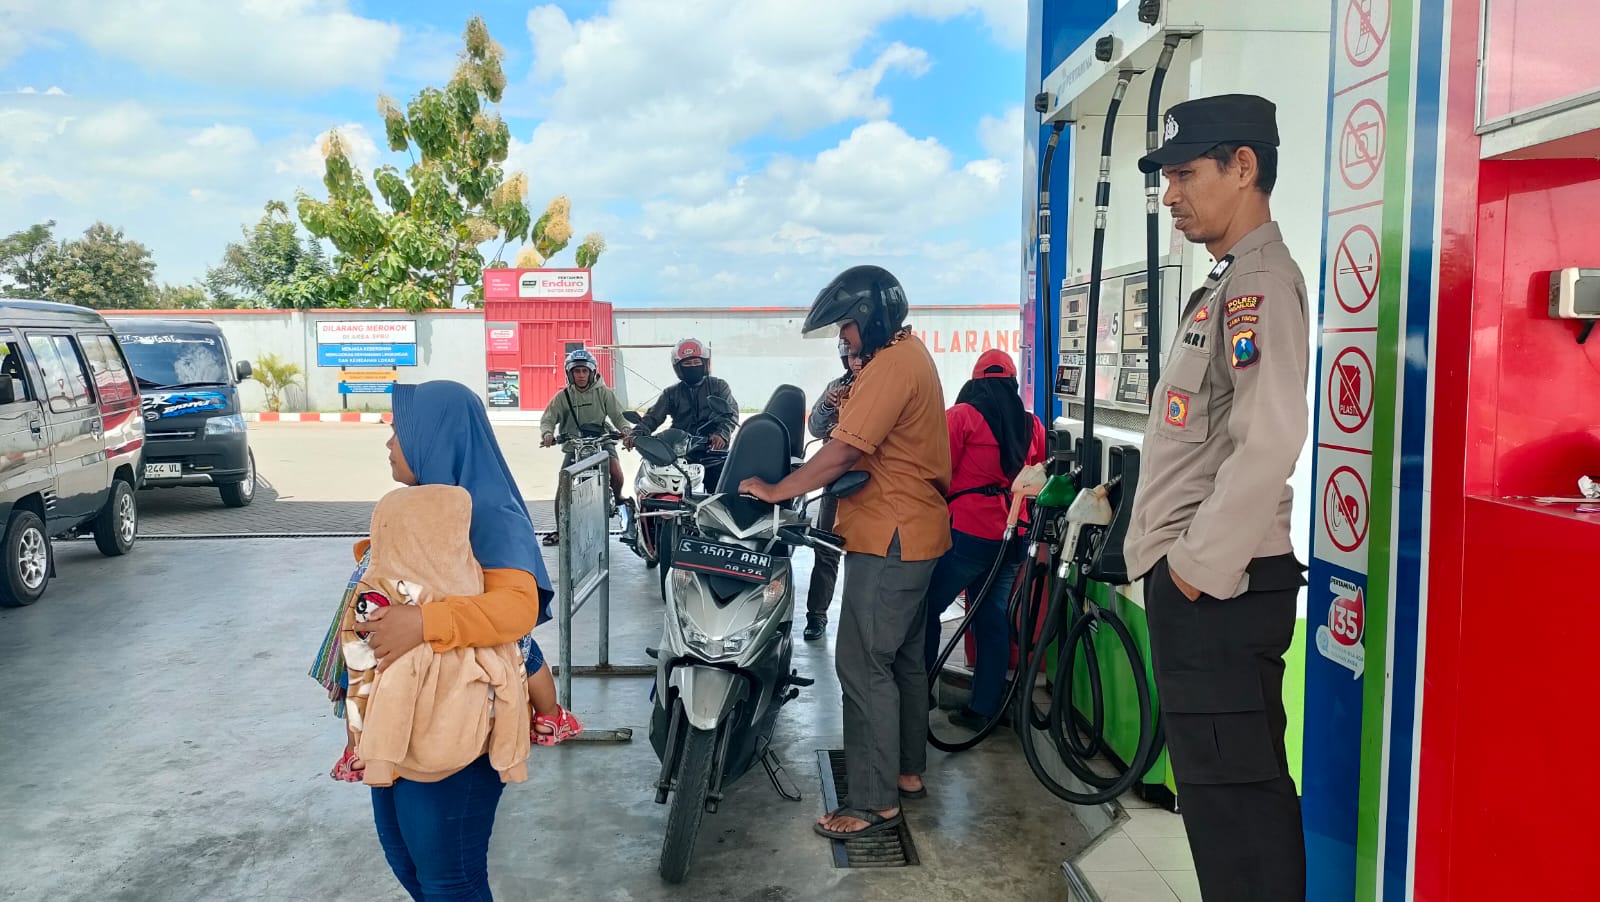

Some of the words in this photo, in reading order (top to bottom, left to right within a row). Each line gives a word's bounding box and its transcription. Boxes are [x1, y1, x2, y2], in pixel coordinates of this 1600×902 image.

[1228, 296, 1257, 308] POLRES
[322, 324, 364, 332] DILARANG
[365, 324, 408, 332] MEROKOK
[1111, 312, 1119, 336] 5
[168, 464, 180, 473] VL
[680, 542, 692, 552] S
[699, 545, 734, 558] 3507
[1331, 577, 1357, 592] PERTAMINA
[1329, 604, 1358, 641] 135
